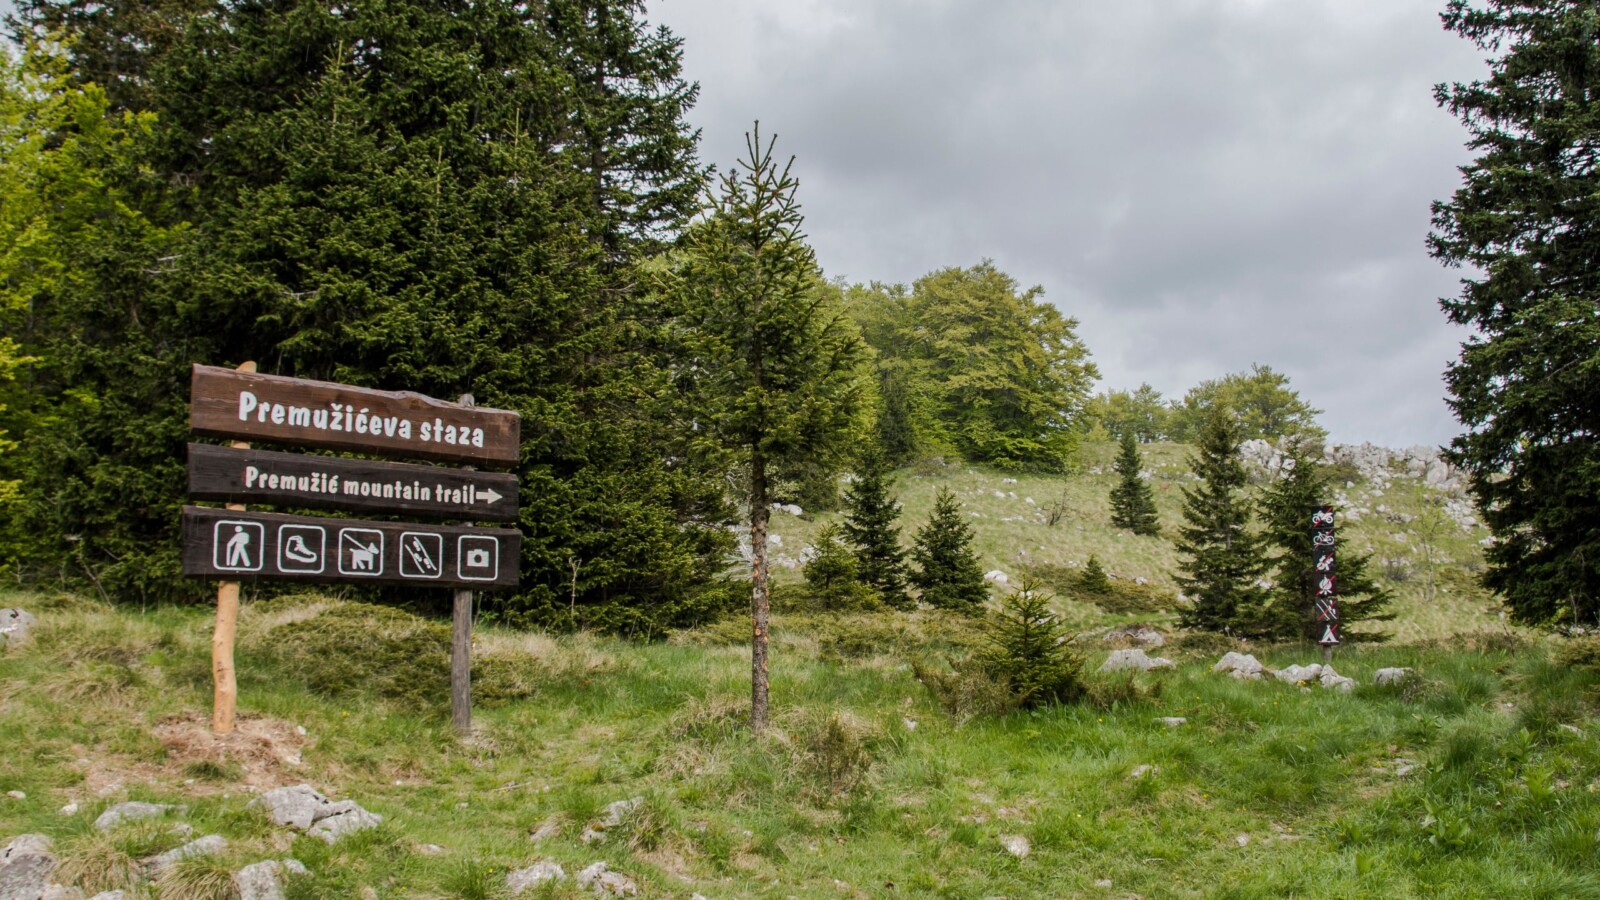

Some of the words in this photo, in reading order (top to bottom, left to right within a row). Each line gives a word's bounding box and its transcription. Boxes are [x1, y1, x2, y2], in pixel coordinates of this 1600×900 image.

[238, 391, 411, 439] Premužićeva
[420, 418, 484, 447] staza
[245, 466, 338, 494] Premužić
[343, 481, 430, 501] mountain
[435, 484, 475, 504] trail
